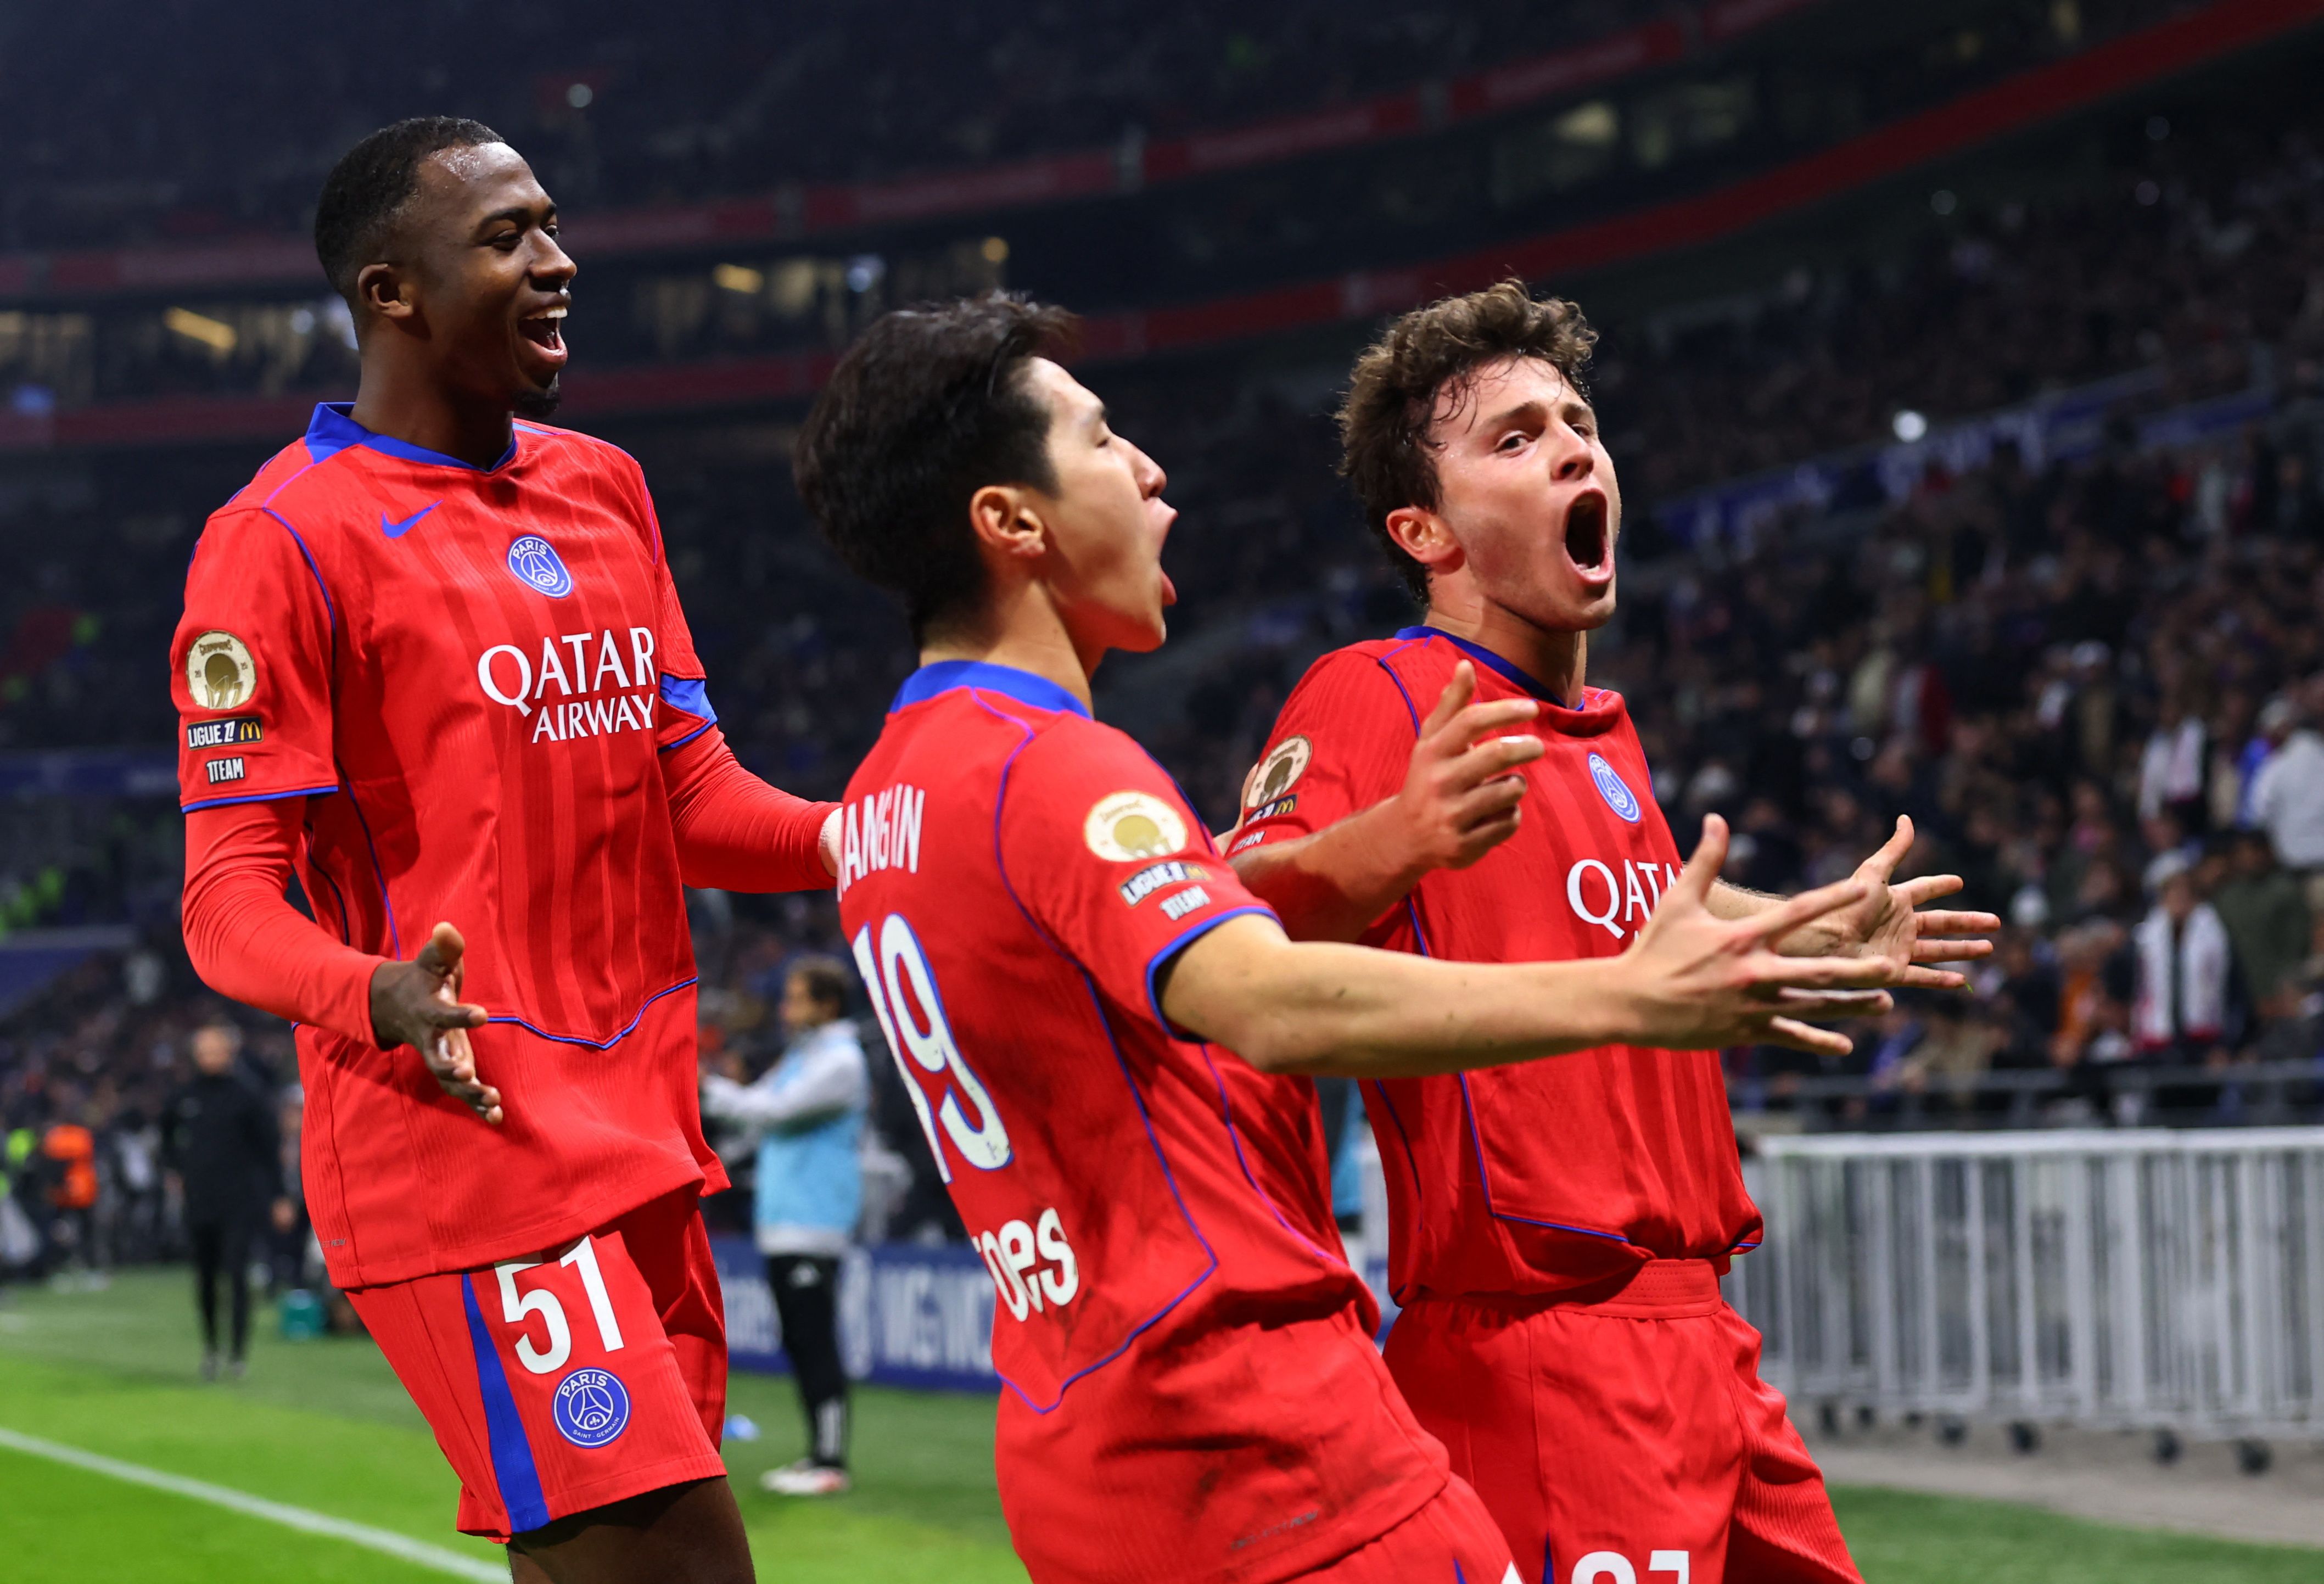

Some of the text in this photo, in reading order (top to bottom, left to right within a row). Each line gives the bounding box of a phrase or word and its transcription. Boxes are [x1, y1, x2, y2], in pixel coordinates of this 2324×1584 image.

[512, 540, 547, 559] PARIS
[478, 627, 656, 717] QATAR
[188, 725, 221, 748] LIGUE
[206, 758, 244, 783] 1TEAM
[1567, 859, 1684, 939] QAT
[852, 911, 1014, 1184] 19
[494, 1235, 625, 1374] 51
[561, 1373, 608, 1397] PARIS
